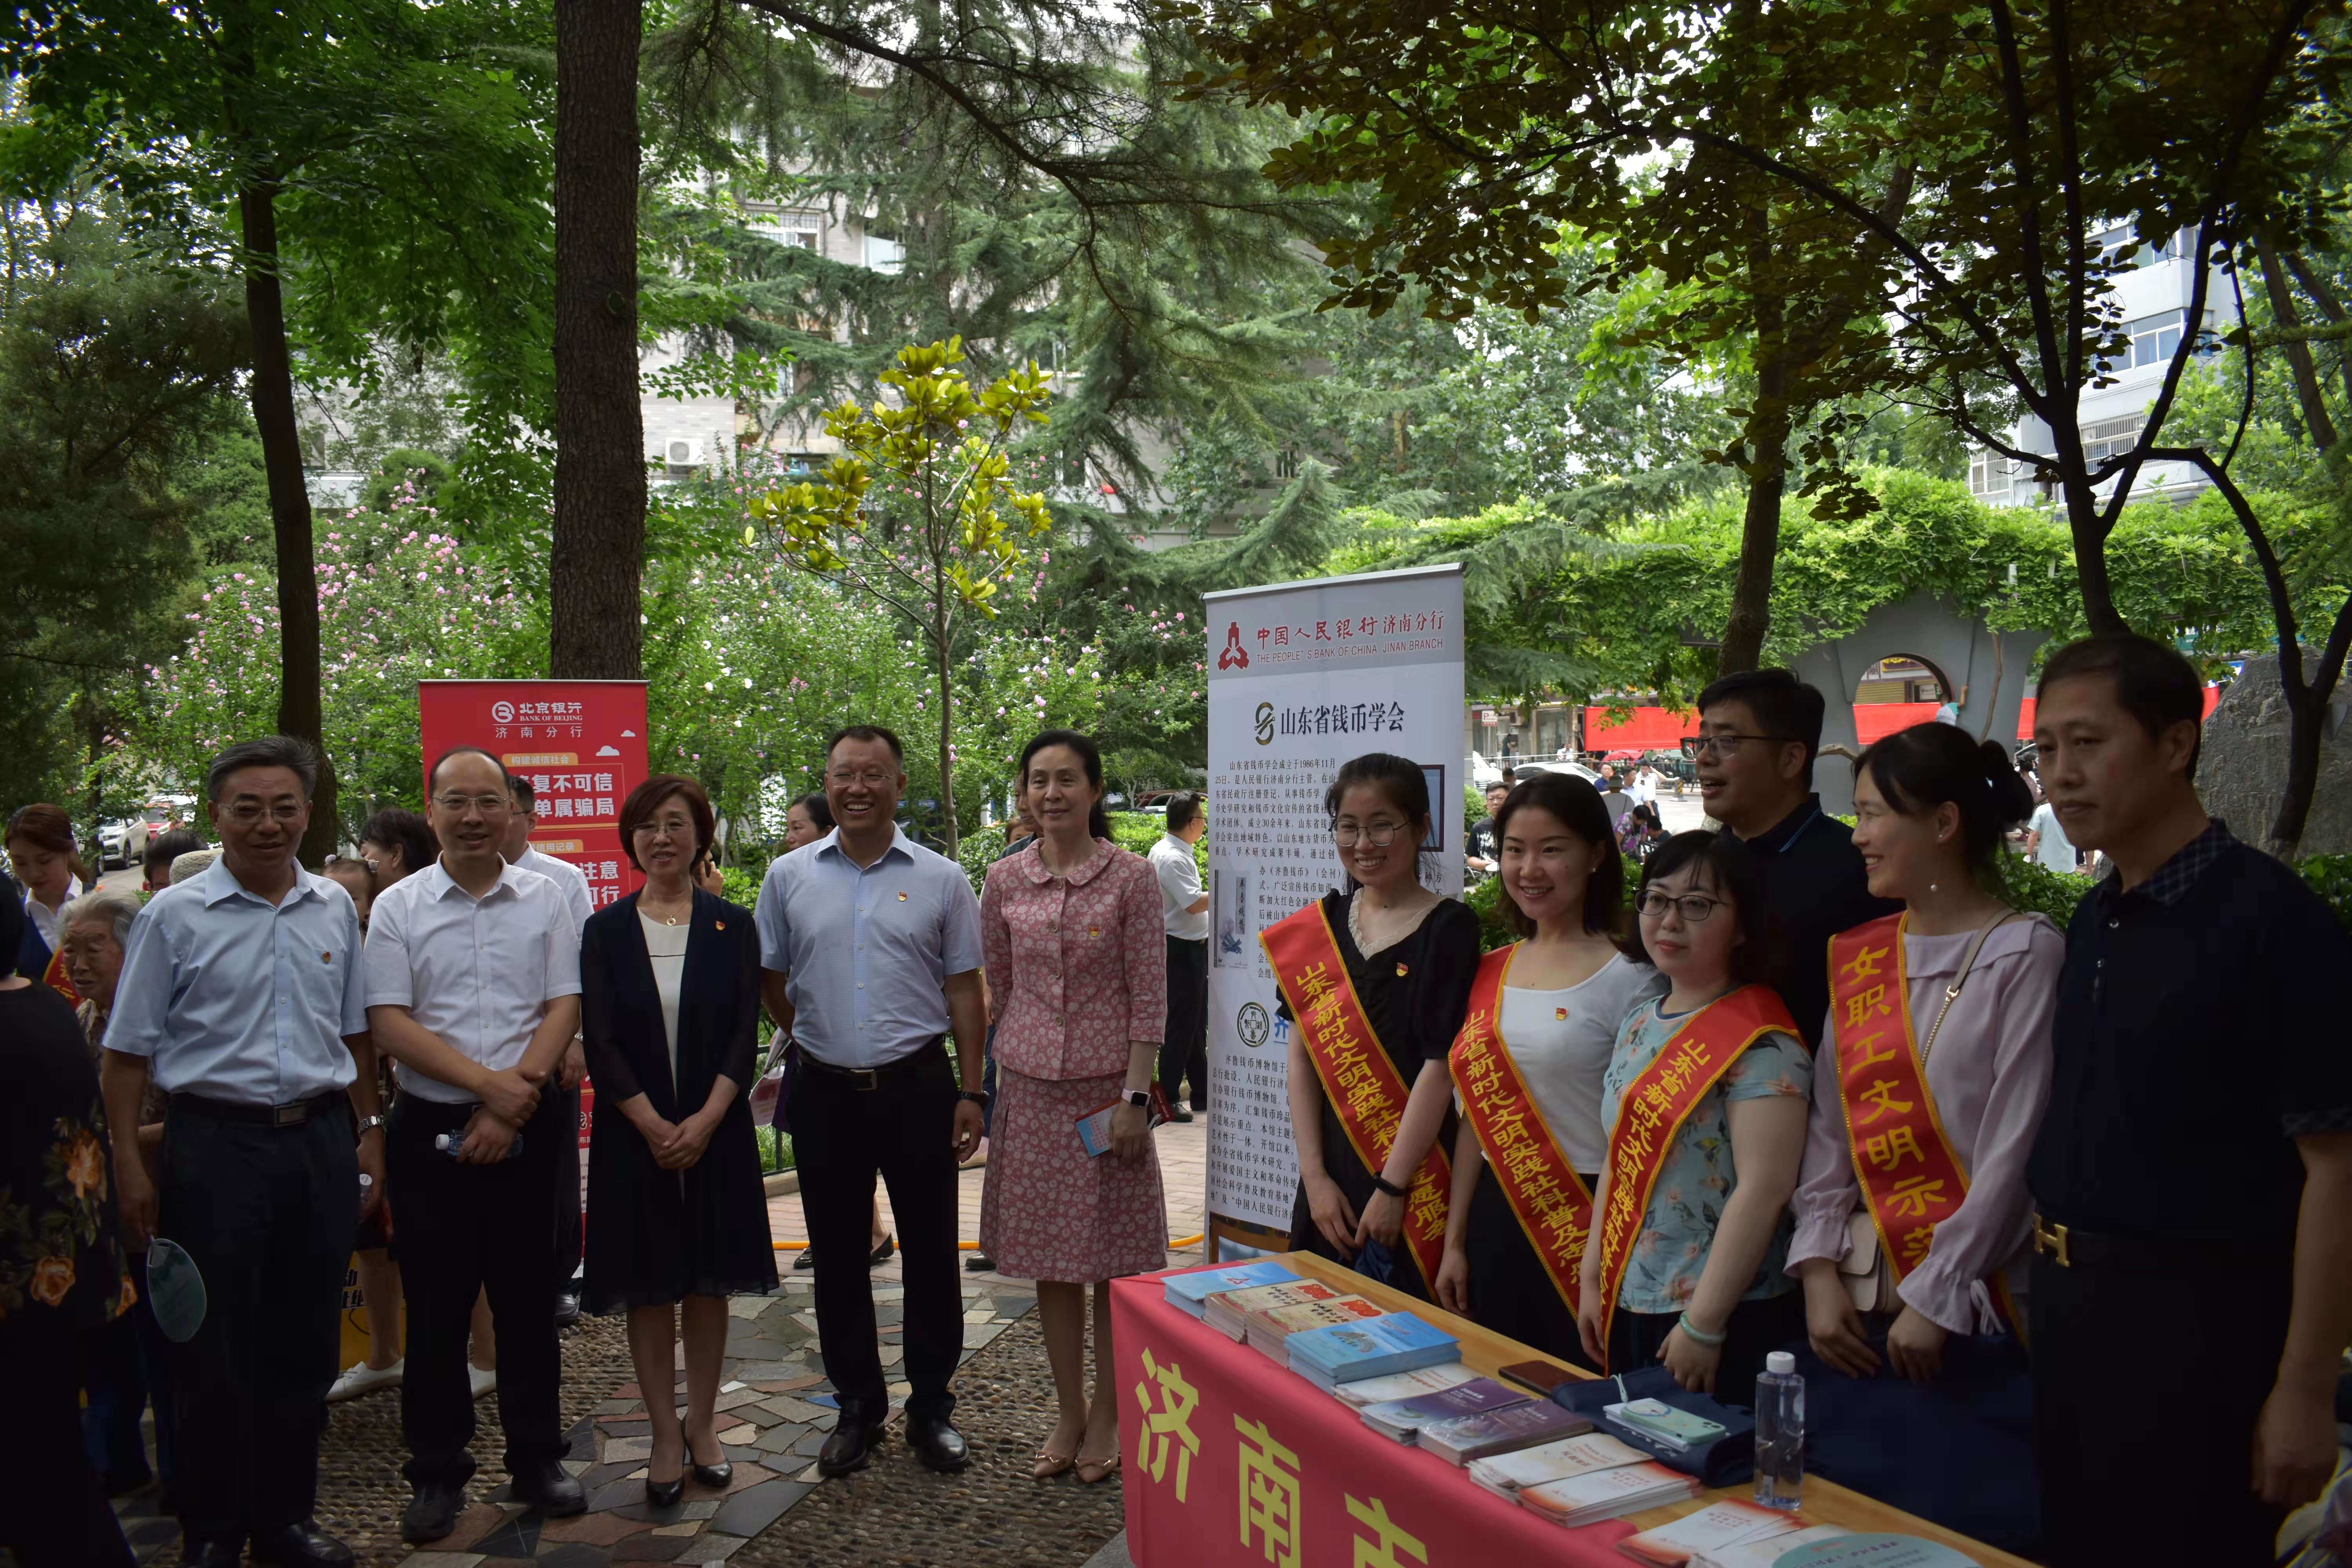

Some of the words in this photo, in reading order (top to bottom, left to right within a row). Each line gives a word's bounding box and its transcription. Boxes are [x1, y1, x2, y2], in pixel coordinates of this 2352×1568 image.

[1257, 610, 1444, 651] 中国人民银行济南分行
[1257, 653, 1270, 663] THE
[1307, 650, 1312, 659] S
[1314, 648, 1335, 659] BANK
[1338, 646, 1349, 656] OF
[1352, 644, 1377, 655] CHINA
[1383, 641, 1406, 653] JINAN
[1409, 638, 1443, 650] BRANCH
[519, 702, 583, 714] 北京银行
[1281, 701, 1405, 736] 山东省钱币学会
[495, 726, 583, 739] 济南分行
[512, 755, 570, 764] 构建诚信社会
[1230, 758, 1335, 770] 山东省钱币学会成立于1986年11月
[572, 861, 619, 880] 注意
